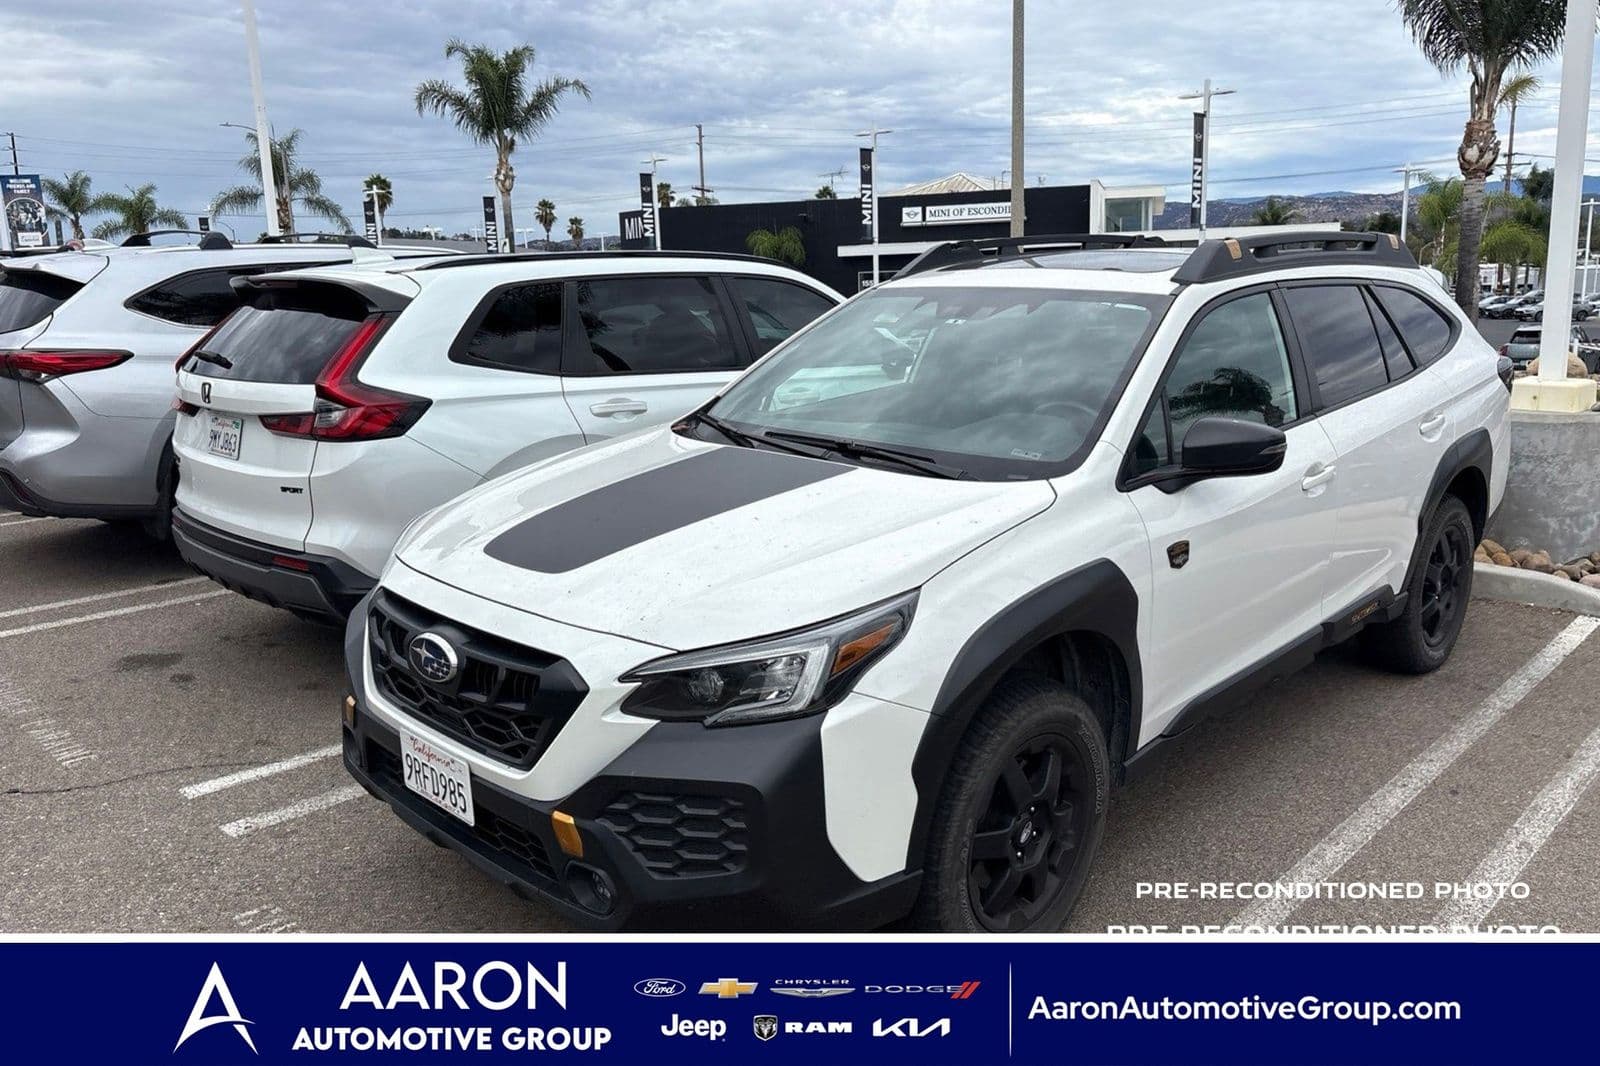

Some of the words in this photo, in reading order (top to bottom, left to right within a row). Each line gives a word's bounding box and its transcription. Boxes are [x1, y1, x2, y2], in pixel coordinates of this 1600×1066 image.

[1192, 158, 1202, 208] MINI
[642, 203, 655, 237] MINI
[862, 184, 872, 225] MINI
[929, 210, 950, 218] MINI
[952, 208, 965, 216] OF
[967, 205, 1011, 216] ESCONDI
[486, 221, 497, 250] MINI
[625, 216, 644, 240] MIN
[413, 739, 451, 767] California
[406, 753, 467, 813] 9RFD985
